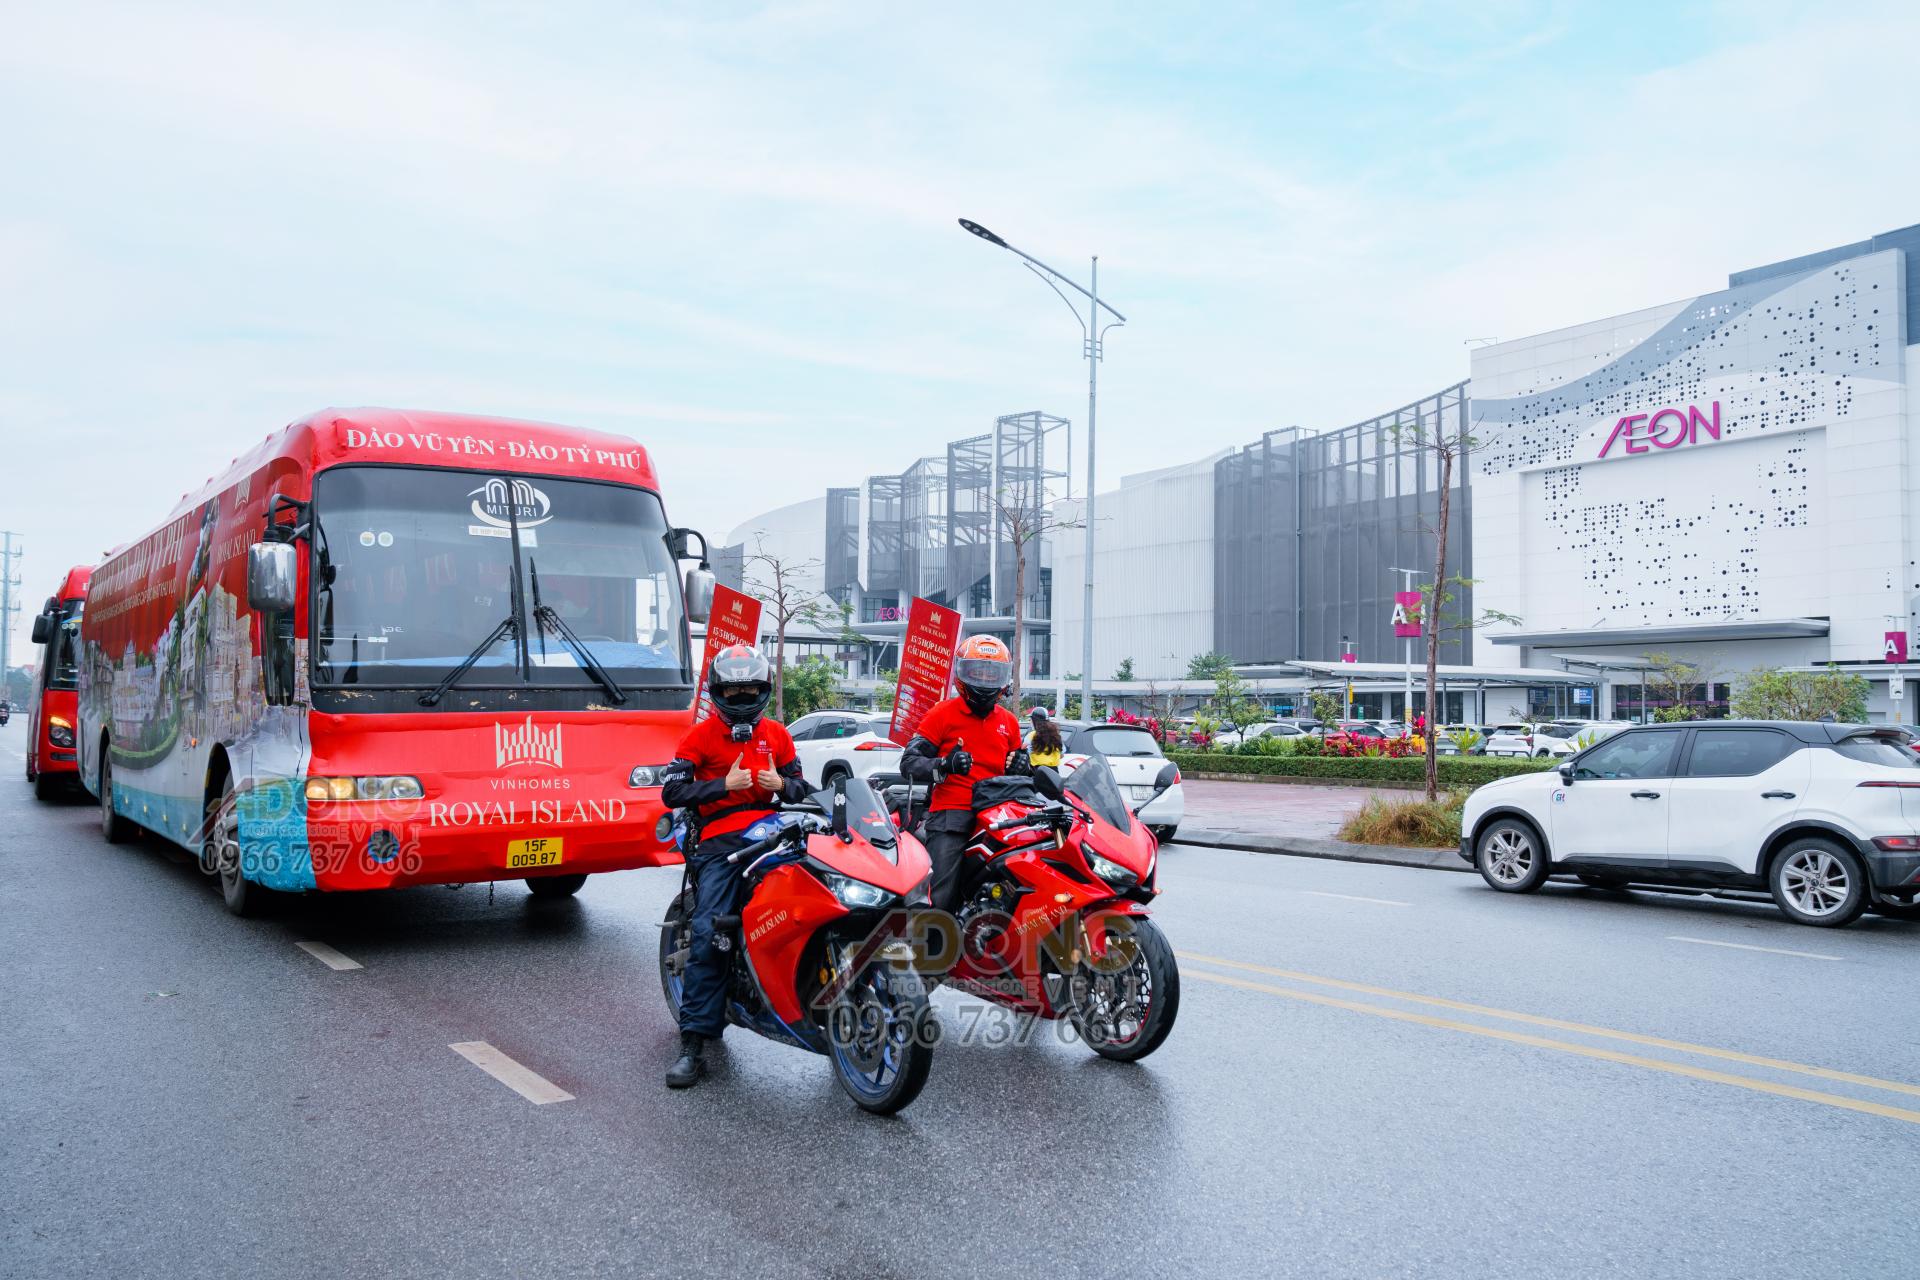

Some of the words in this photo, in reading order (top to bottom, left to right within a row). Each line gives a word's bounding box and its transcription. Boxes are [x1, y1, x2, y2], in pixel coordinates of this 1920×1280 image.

[408, 433, 444, 451] VŨ
[447, 436, 495, 455] YÊN
[490, 778, 571, 790] VINHOMES
[430, 800, 524, 827] ROYAL
[531, 798, 626, 824] ISLAND
[524, 839, 547, 852] 15F
[512, 852, 557, 867] 009.87
